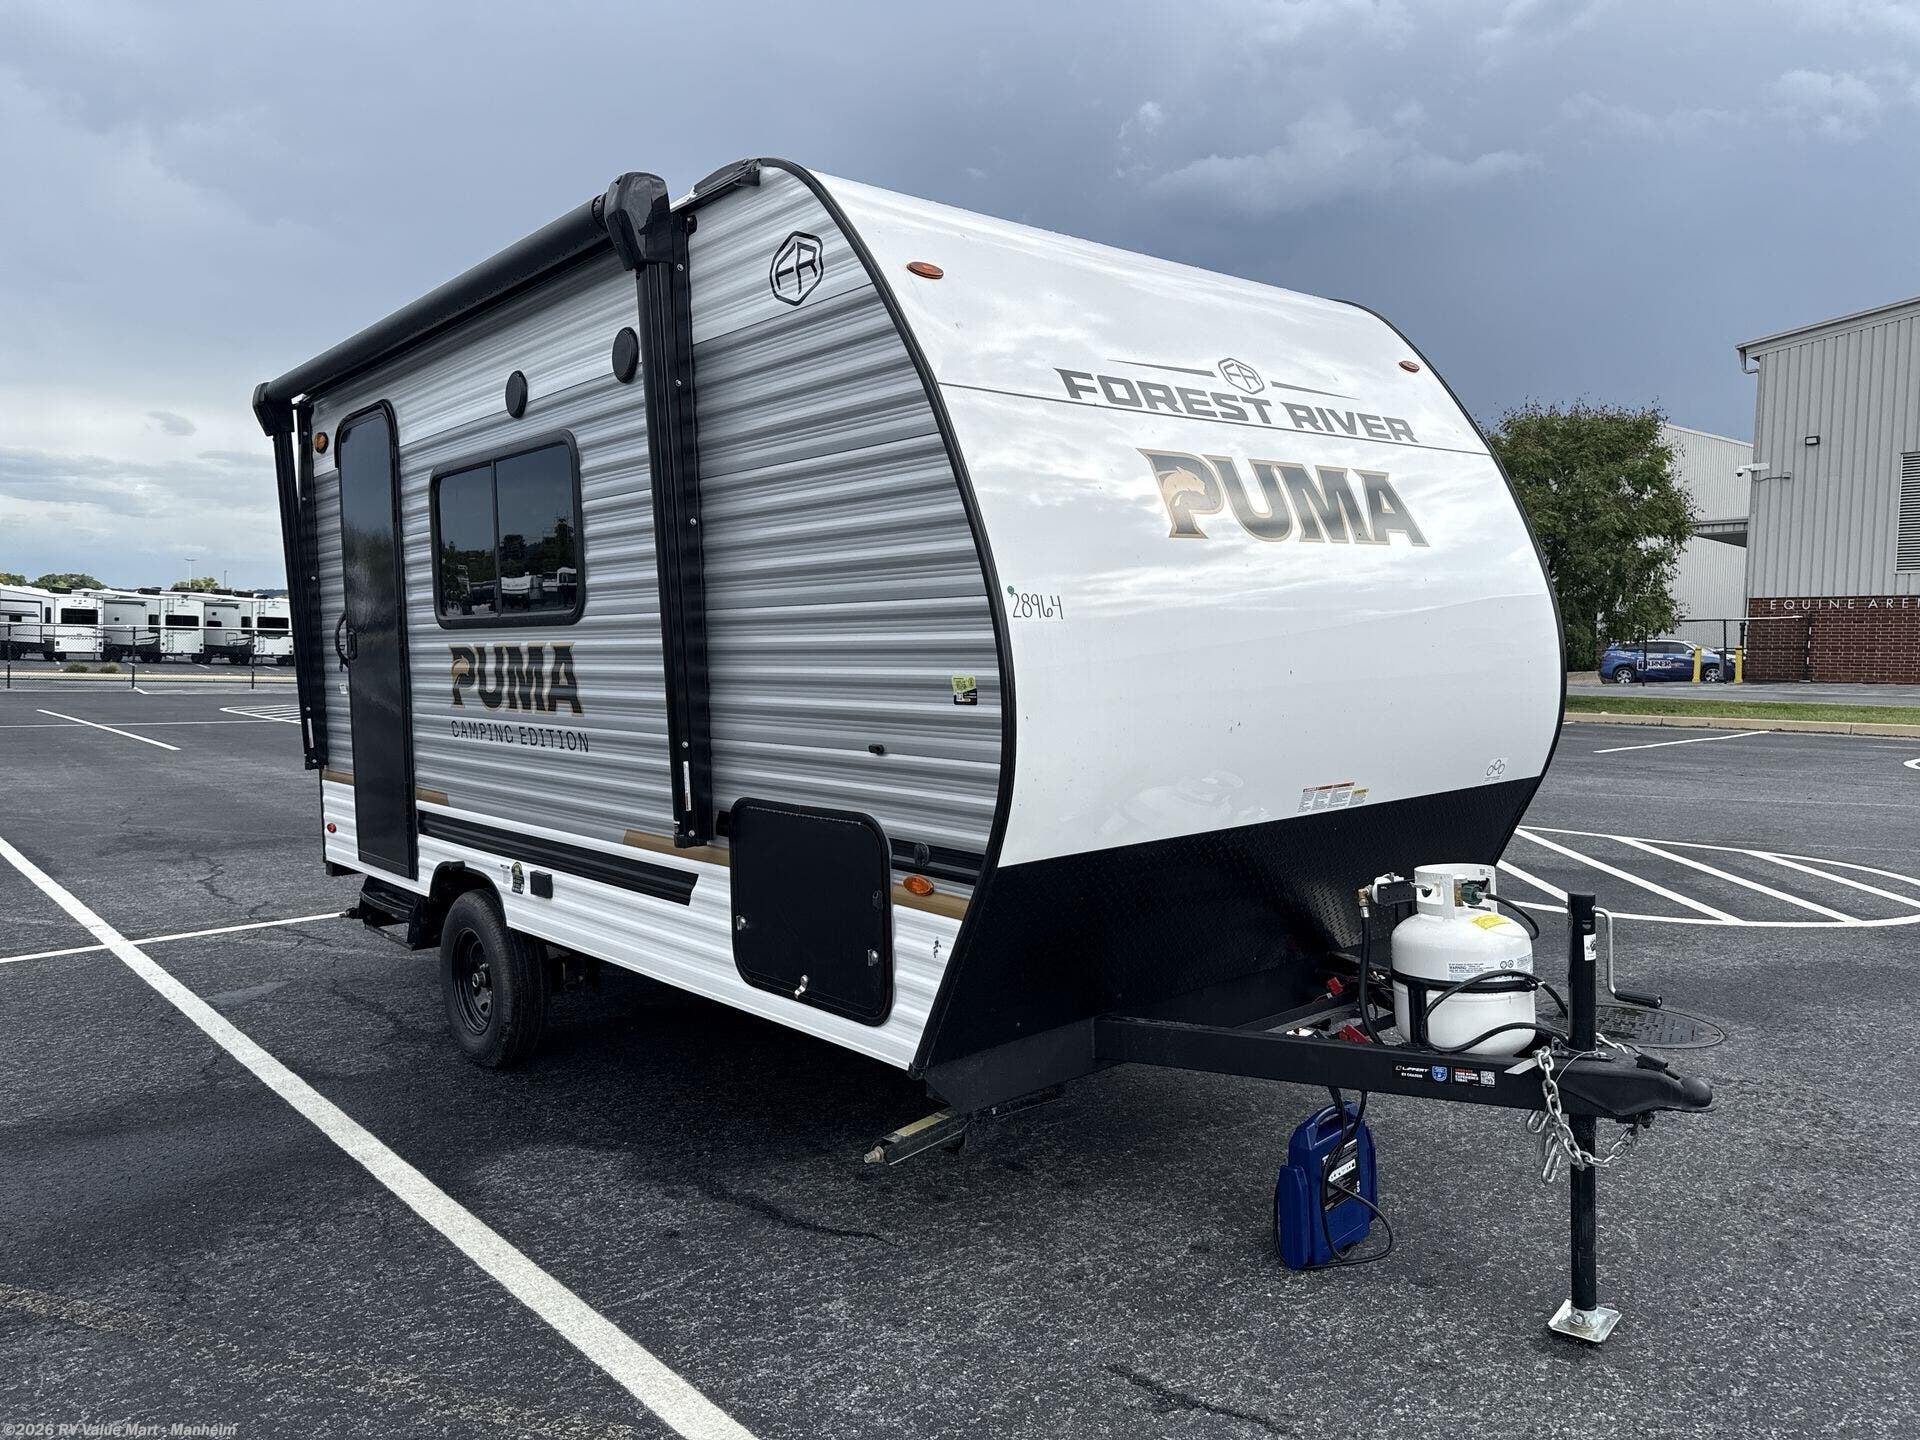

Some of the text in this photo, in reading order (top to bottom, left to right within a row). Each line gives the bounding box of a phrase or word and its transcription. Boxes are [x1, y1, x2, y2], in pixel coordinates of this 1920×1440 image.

[1053, 368, 1420, 443] FOREST RIVER
[1135, 447, 1430, 547] PUMA
[1011, 592, 1064, 620] 28964
[1770, 599, 1855, 610] EQUINE
[448, 640, 585, 717] PUMA
[450, 720, 589, 752] CAMPING EDITION
